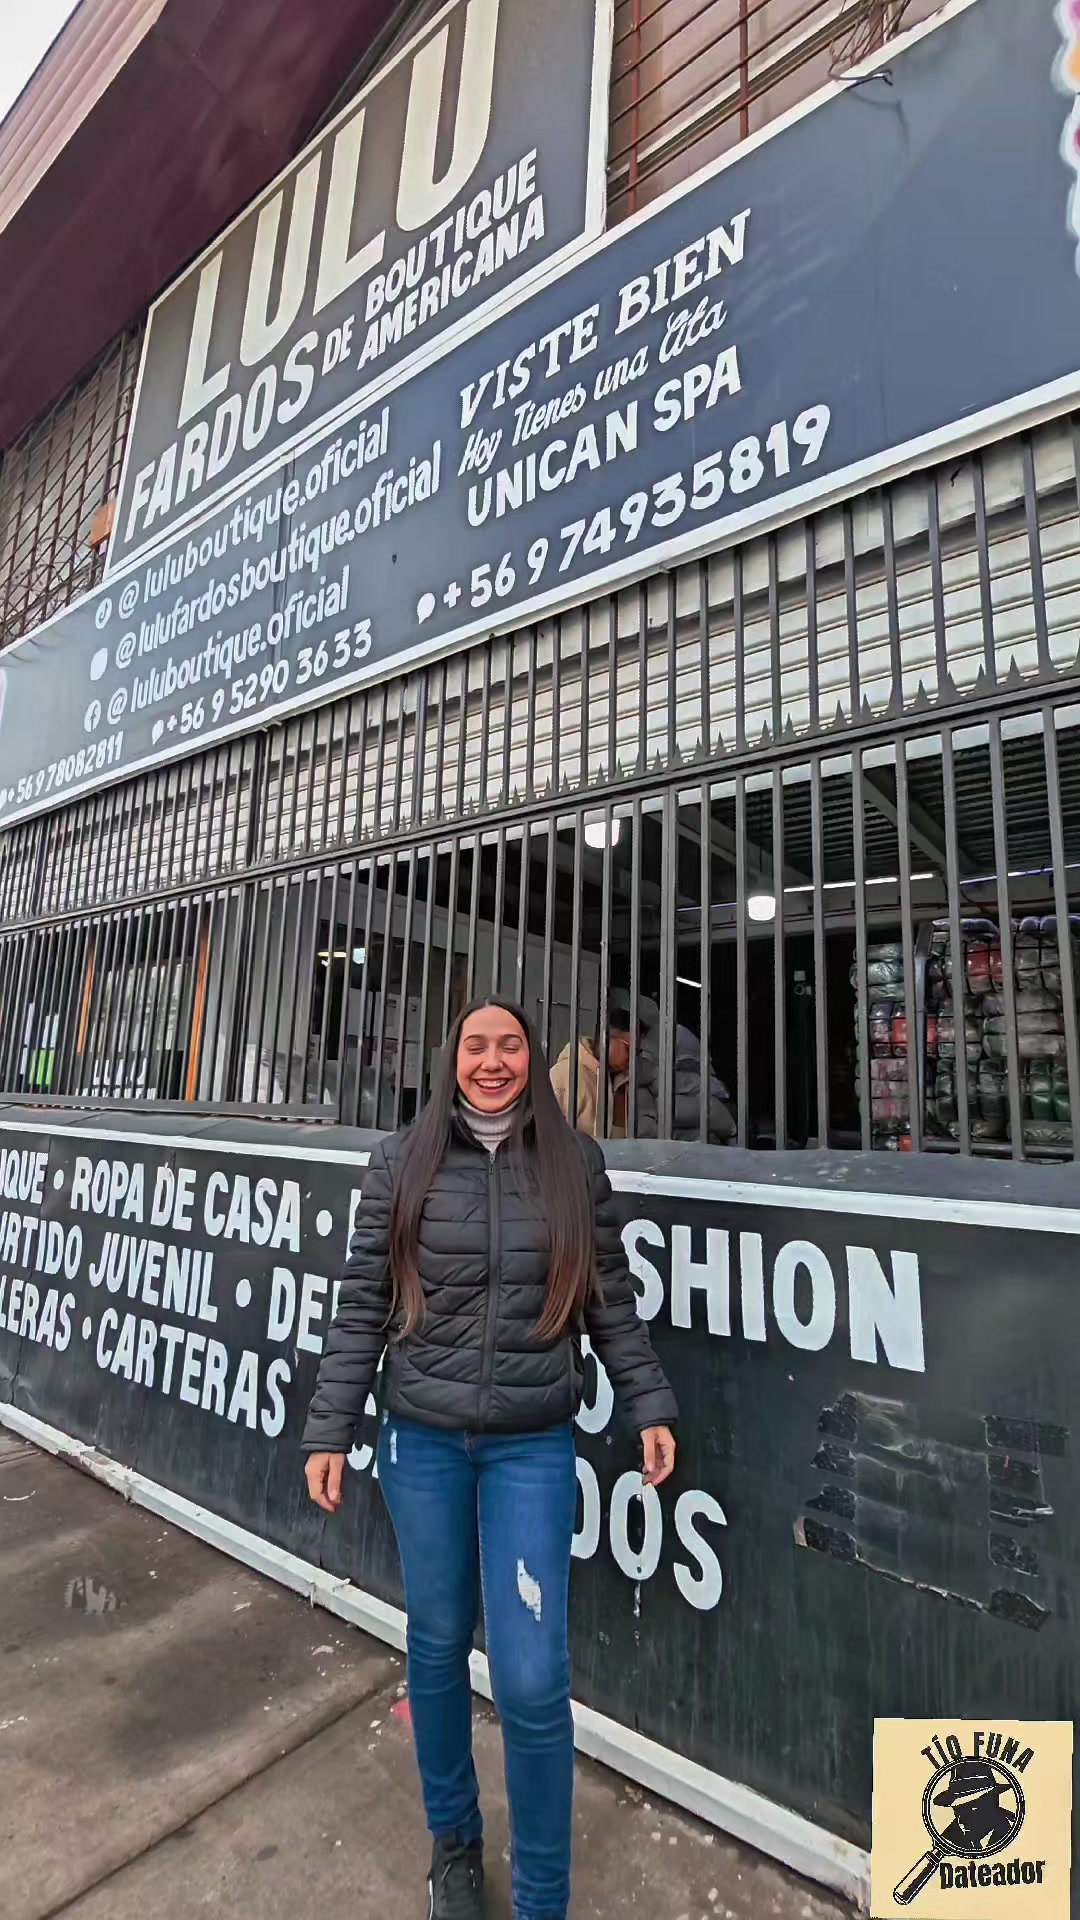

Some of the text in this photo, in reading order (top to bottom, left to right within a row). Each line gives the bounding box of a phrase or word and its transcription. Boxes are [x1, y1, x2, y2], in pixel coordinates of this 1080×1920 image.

[179, 0, 500, 428] LULU
[366, 148, 537, 322] BOUTIQUE
[124, 195, 544, 544] FARDOS DE AMERICANA
[460, 208, 751, 429] VISTE BIEN
[457, 428, 502, 476] Hoy
[512, 382, 586, 446] Tienes
[593, 345, 649, 400] una
[467, 345, 741, 527] UNICAN SPA
[211, 687, 224, 723] 9
[229, 659, 290, 715] 5290
[71, 1156, 145, 1222] ROPA
[150, 1165, 198, 1231] DE
[203, 1171, 301, 1253] CASA
[89, 1231, 218, 1323] JUVENIL
[96, 1307, 292, 1438] CARTERAS
